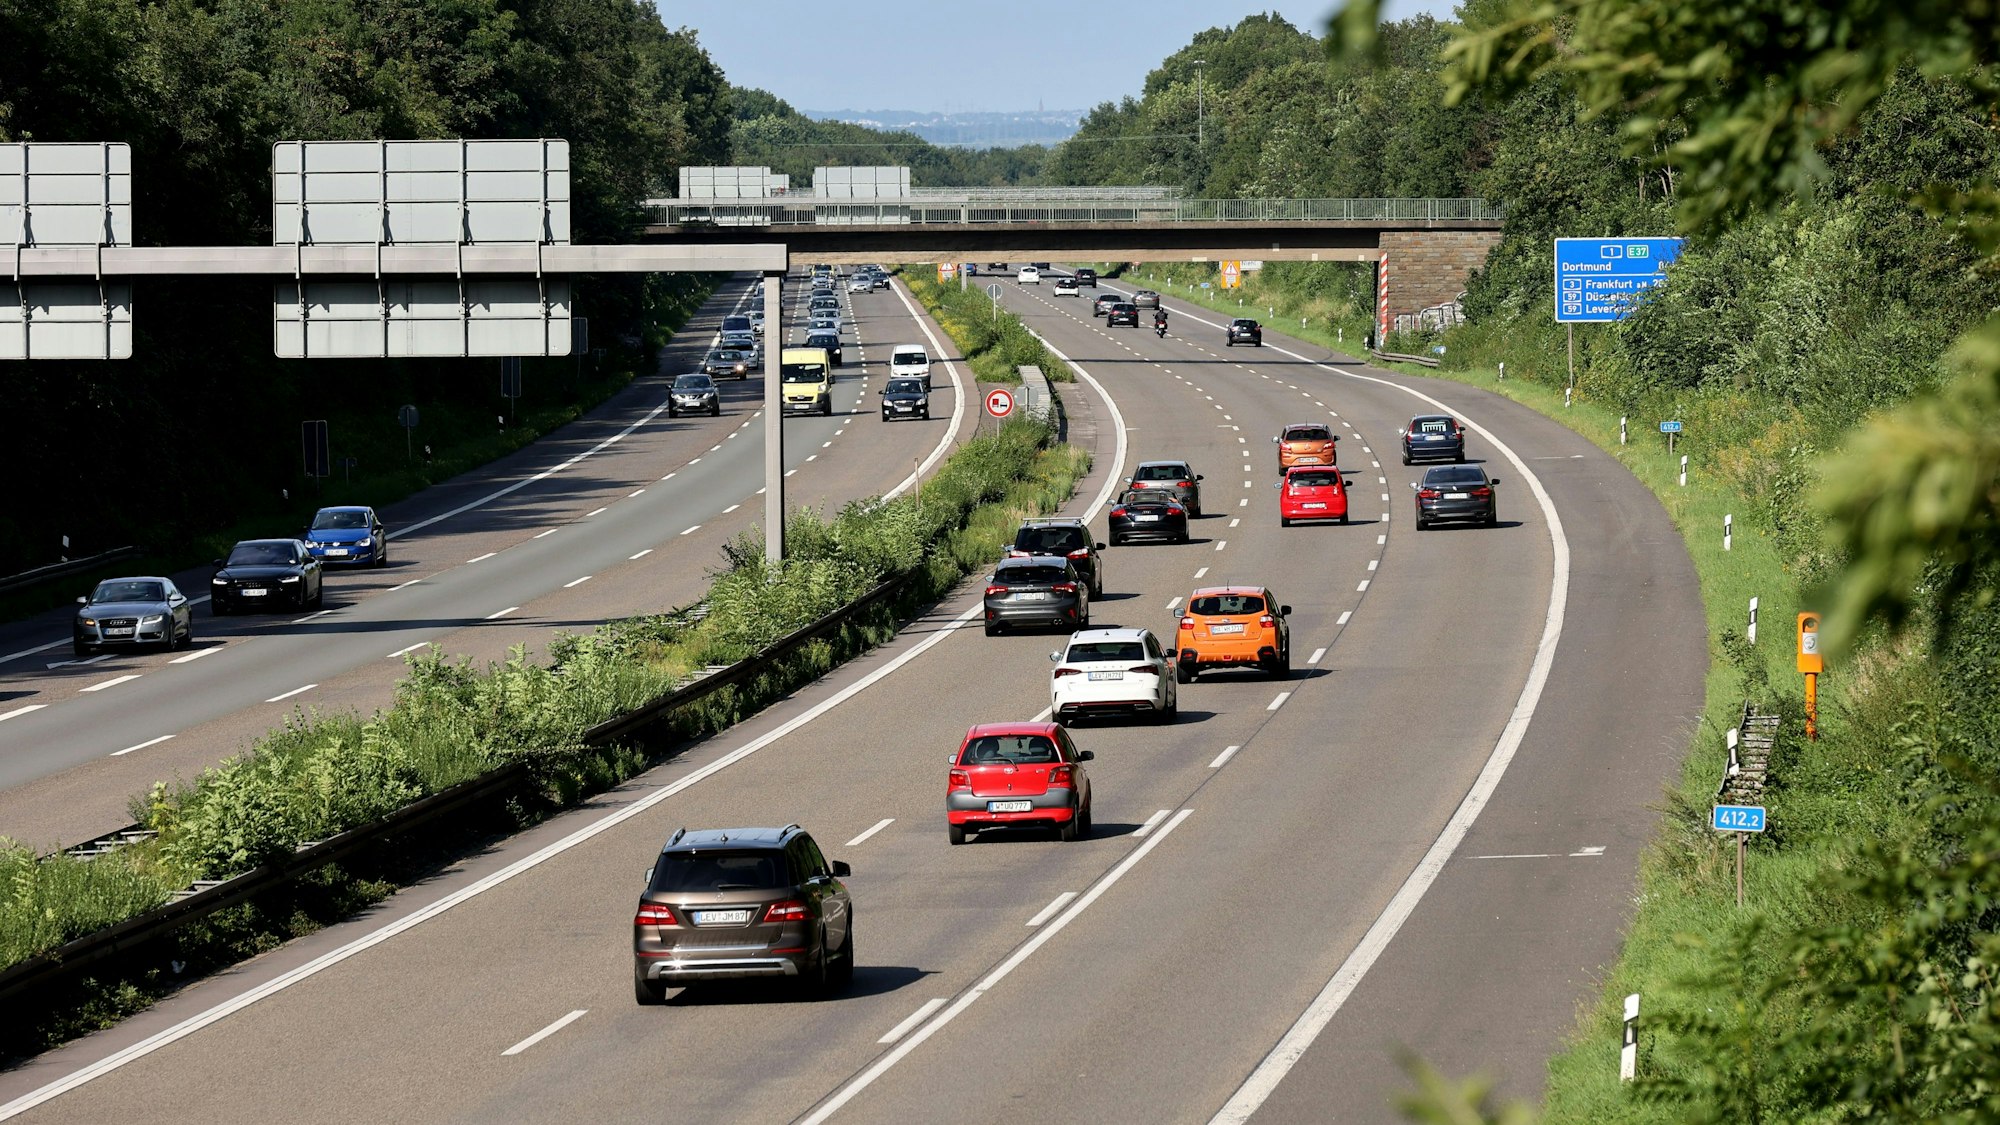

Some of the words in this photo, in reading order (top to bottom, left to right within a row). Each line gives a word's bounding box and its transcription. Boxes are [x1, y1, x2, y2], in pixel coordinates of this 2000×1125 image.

[1562, 262, 1612, 271] Dortmund
[1585, 280, 1633, 289] Frankfurt
[1567, 293, 1577, 301] 59
[1567, 305, 1577, 313] 59
